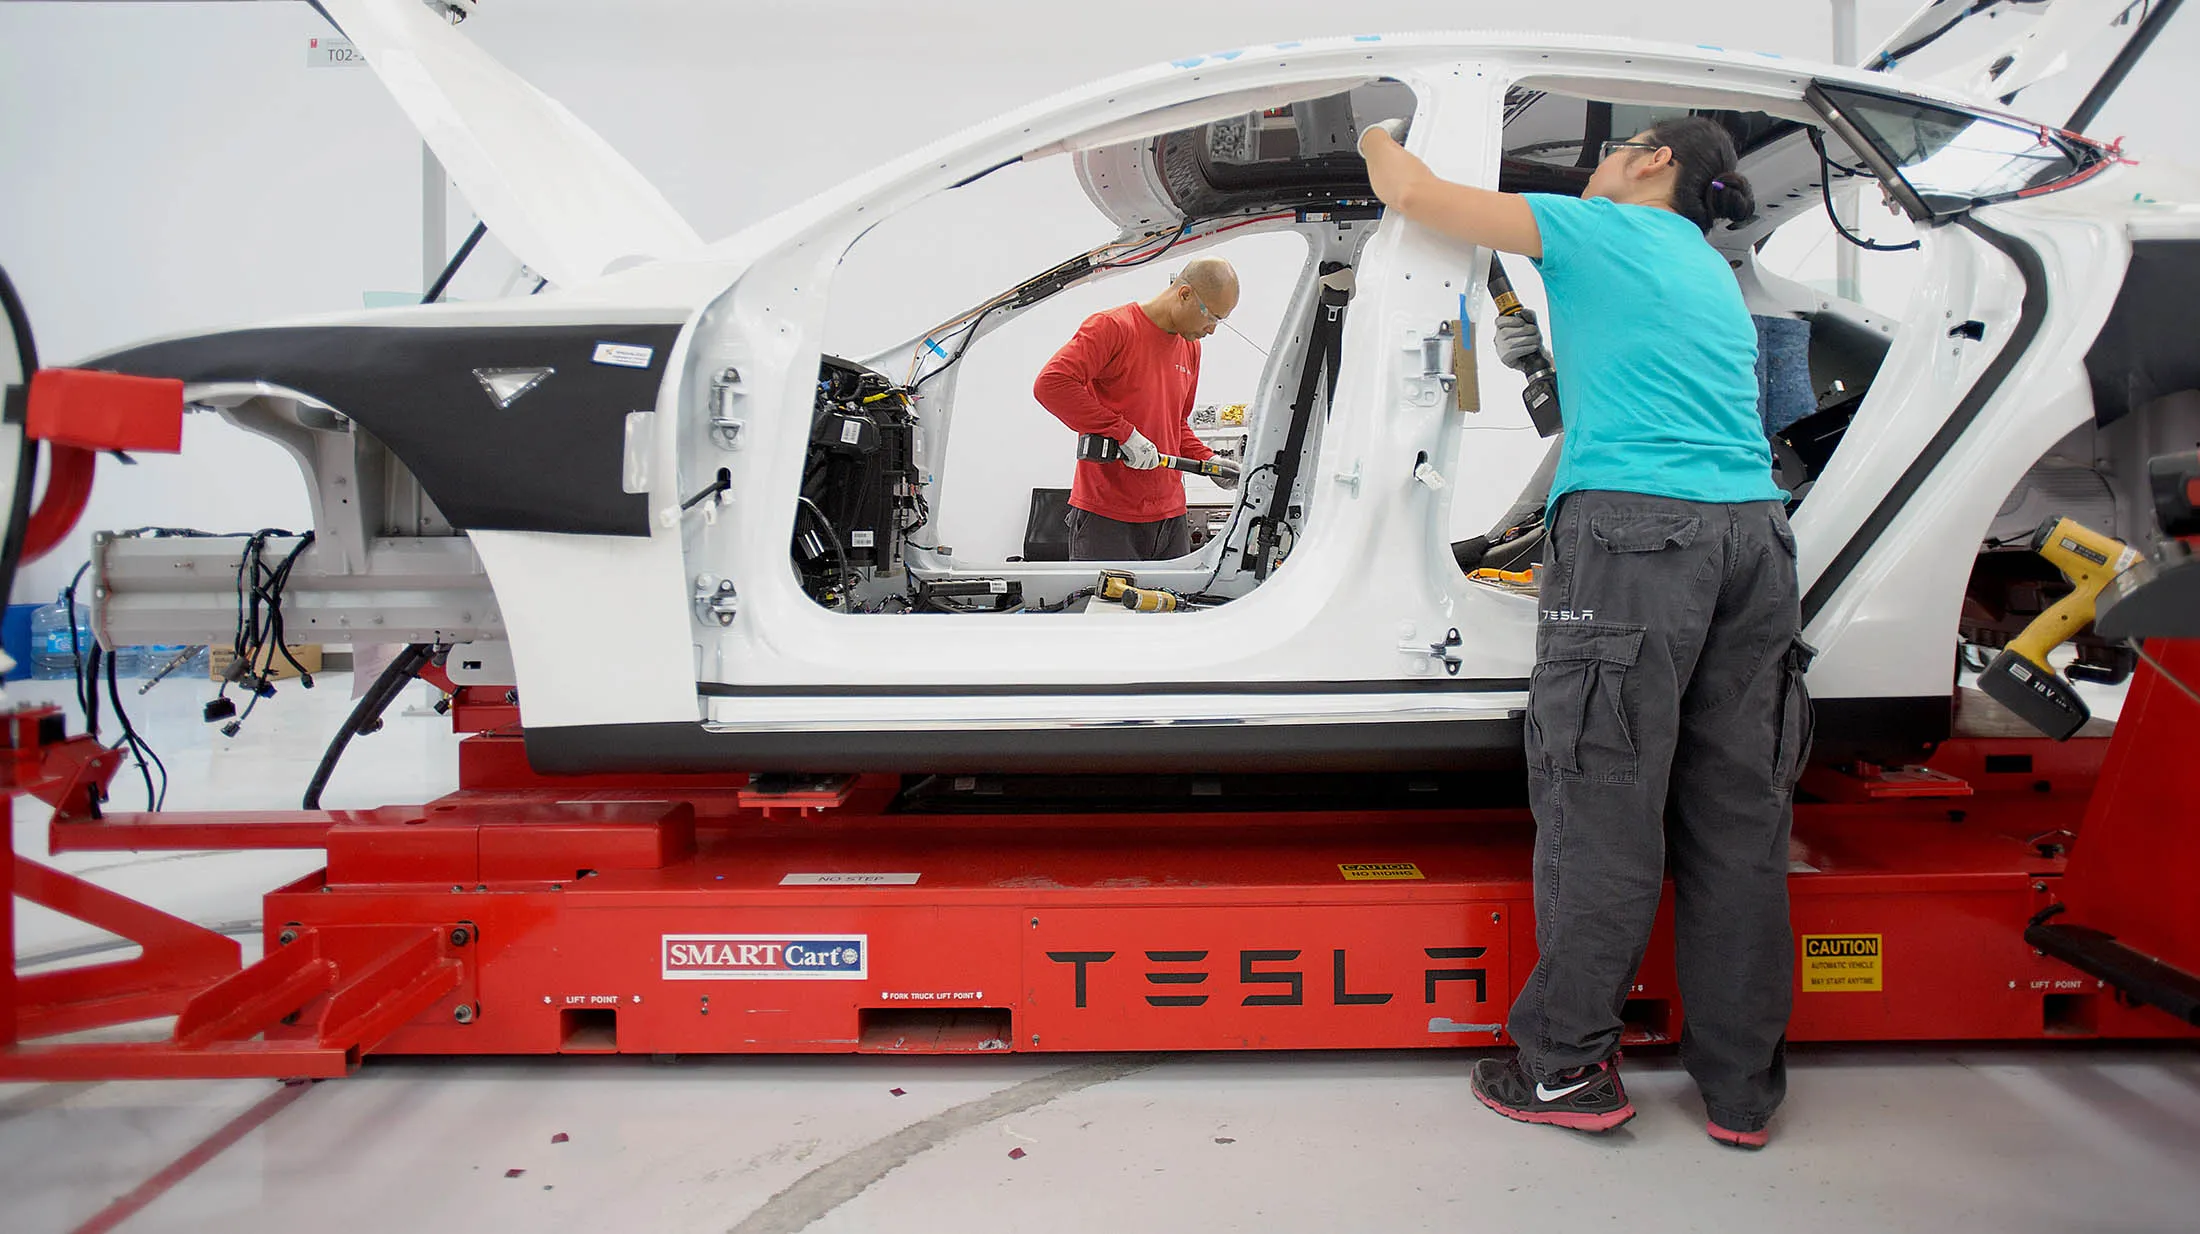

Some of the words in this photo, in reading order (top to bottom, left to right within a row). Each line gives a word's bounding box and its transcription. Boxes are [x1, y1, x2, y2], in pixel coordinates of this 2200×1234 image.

[1542, 609, 1594, 621] TESLA
[1808, 940, 1876, 955] CAUTION
[670, 944, 781, 966] SMART
[1811, 961, 1846, 969] AUTOMATIC
[1848, 961, 1874, 969] VEHICLE
[1045, 947, 1487, 1008] TESLA
[1826, 977, 1846, 985] START
[2030, 981, 2050, 989] LIFT
[2055, 980, 2081, 988] POINT
[565, 996, 585, 1004] LIFT
[590, 996, 618, 1004] POINT
